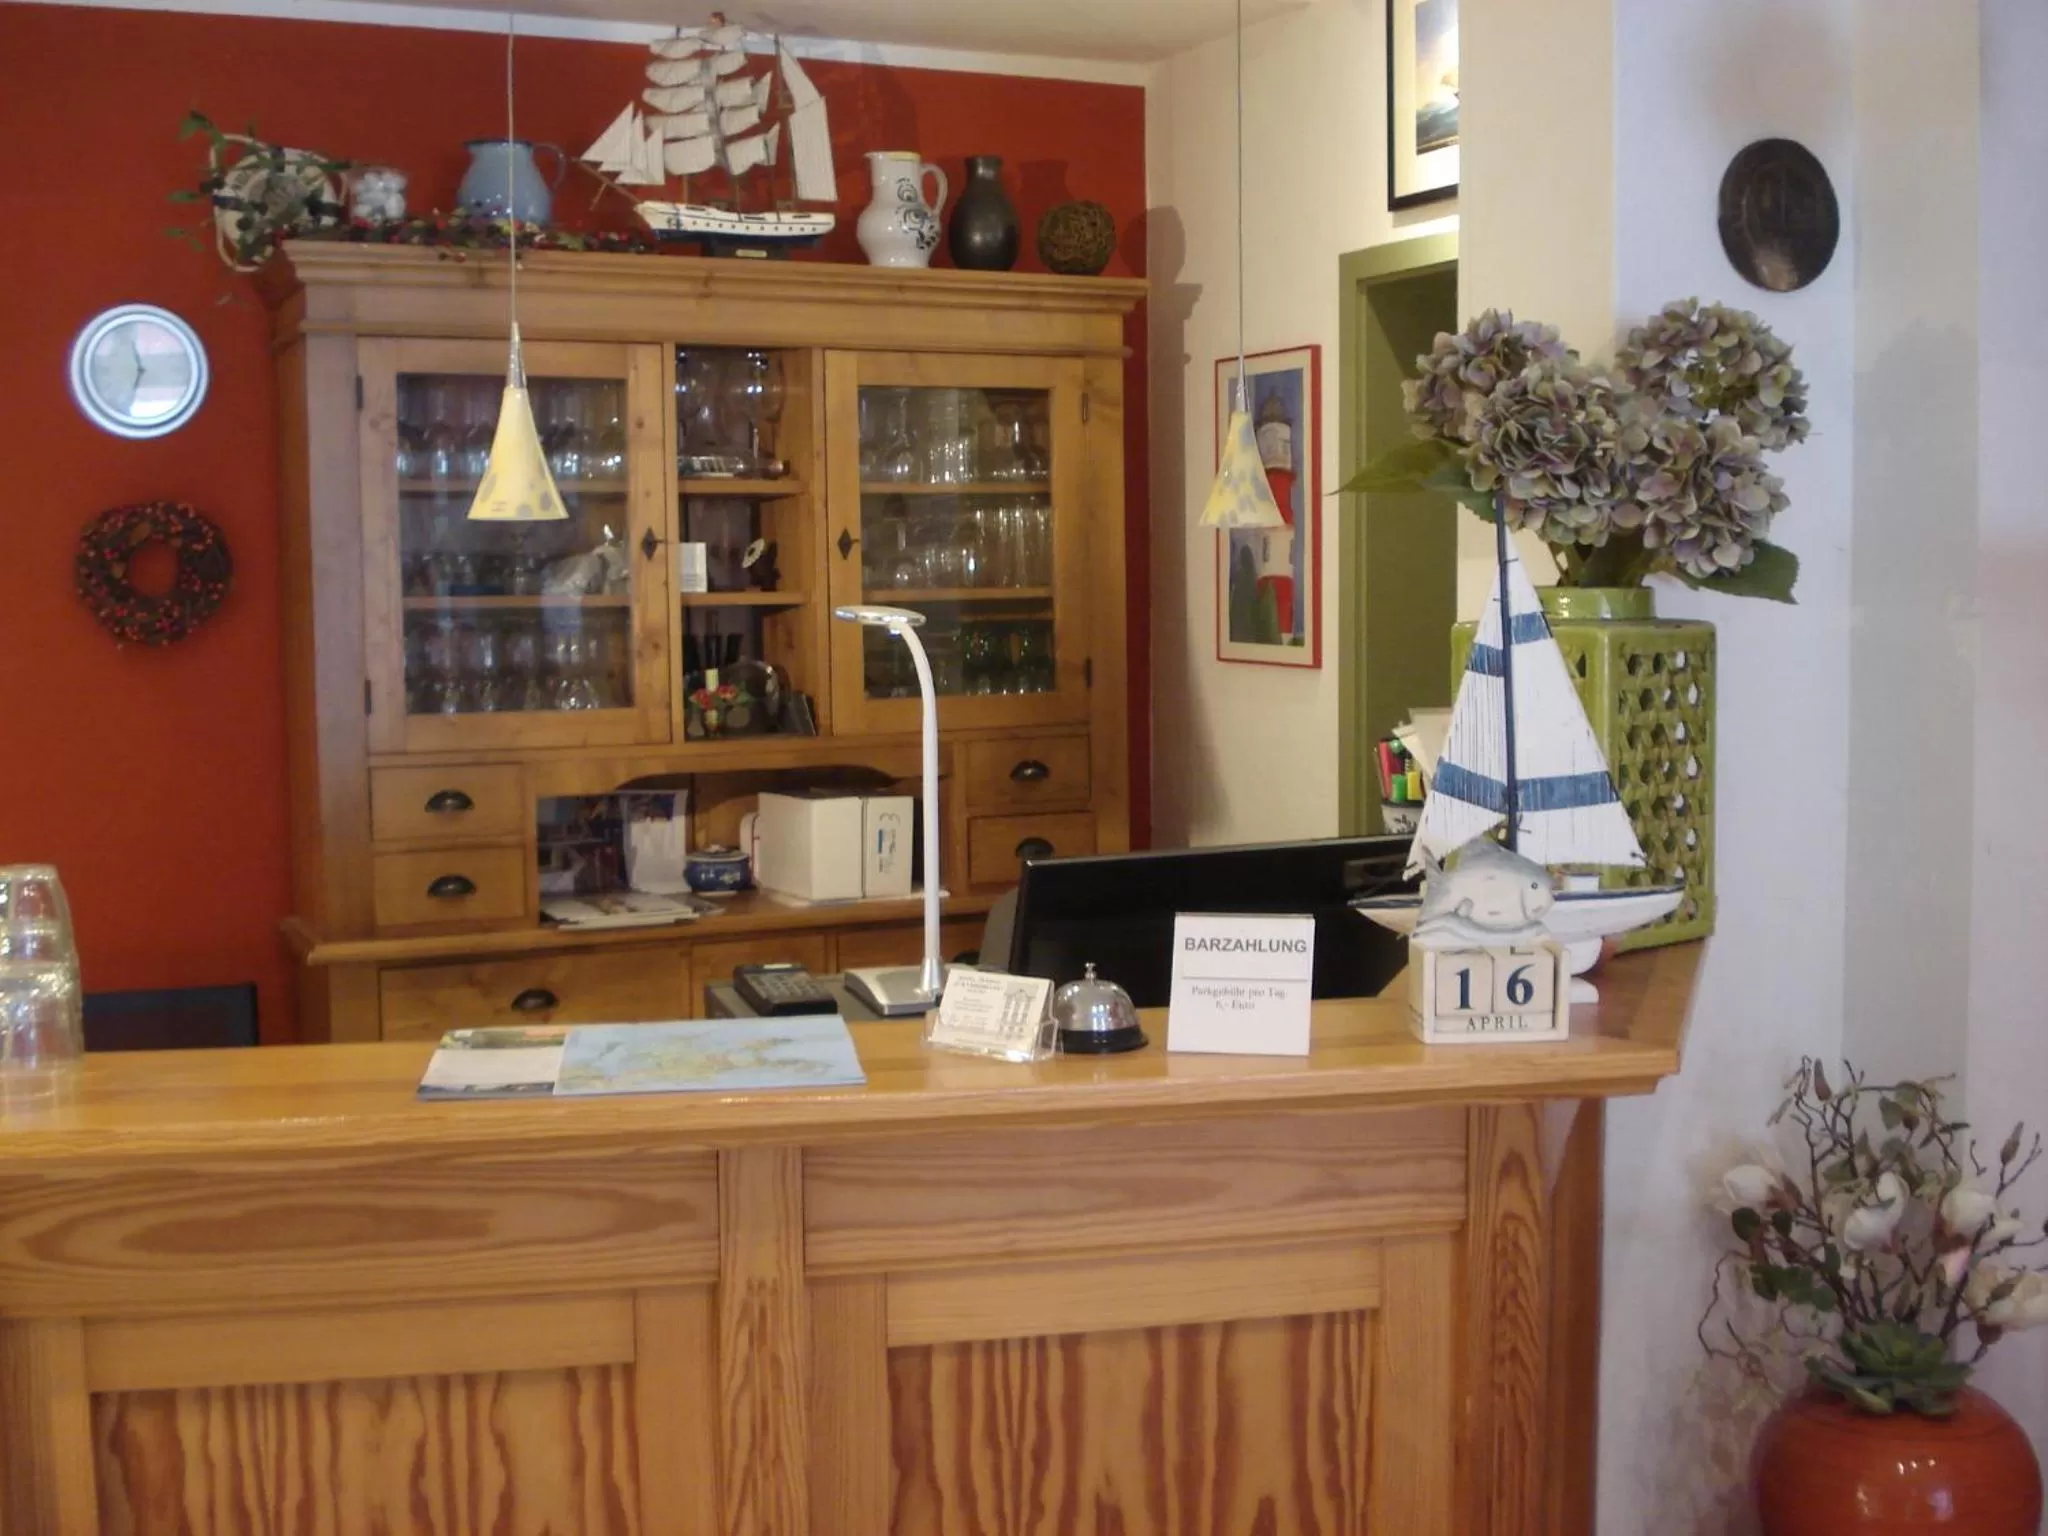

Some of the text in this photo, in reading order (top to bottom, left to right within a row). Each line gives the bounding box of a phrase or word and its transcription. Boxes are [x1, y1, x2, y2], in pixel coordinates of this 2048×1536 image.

[1184, 937, 1307, 953] BARZAHLUNG
[1455, 963, 1535, 1010] 1 6
[1467, 1015, 1529, 1032] APRIL
